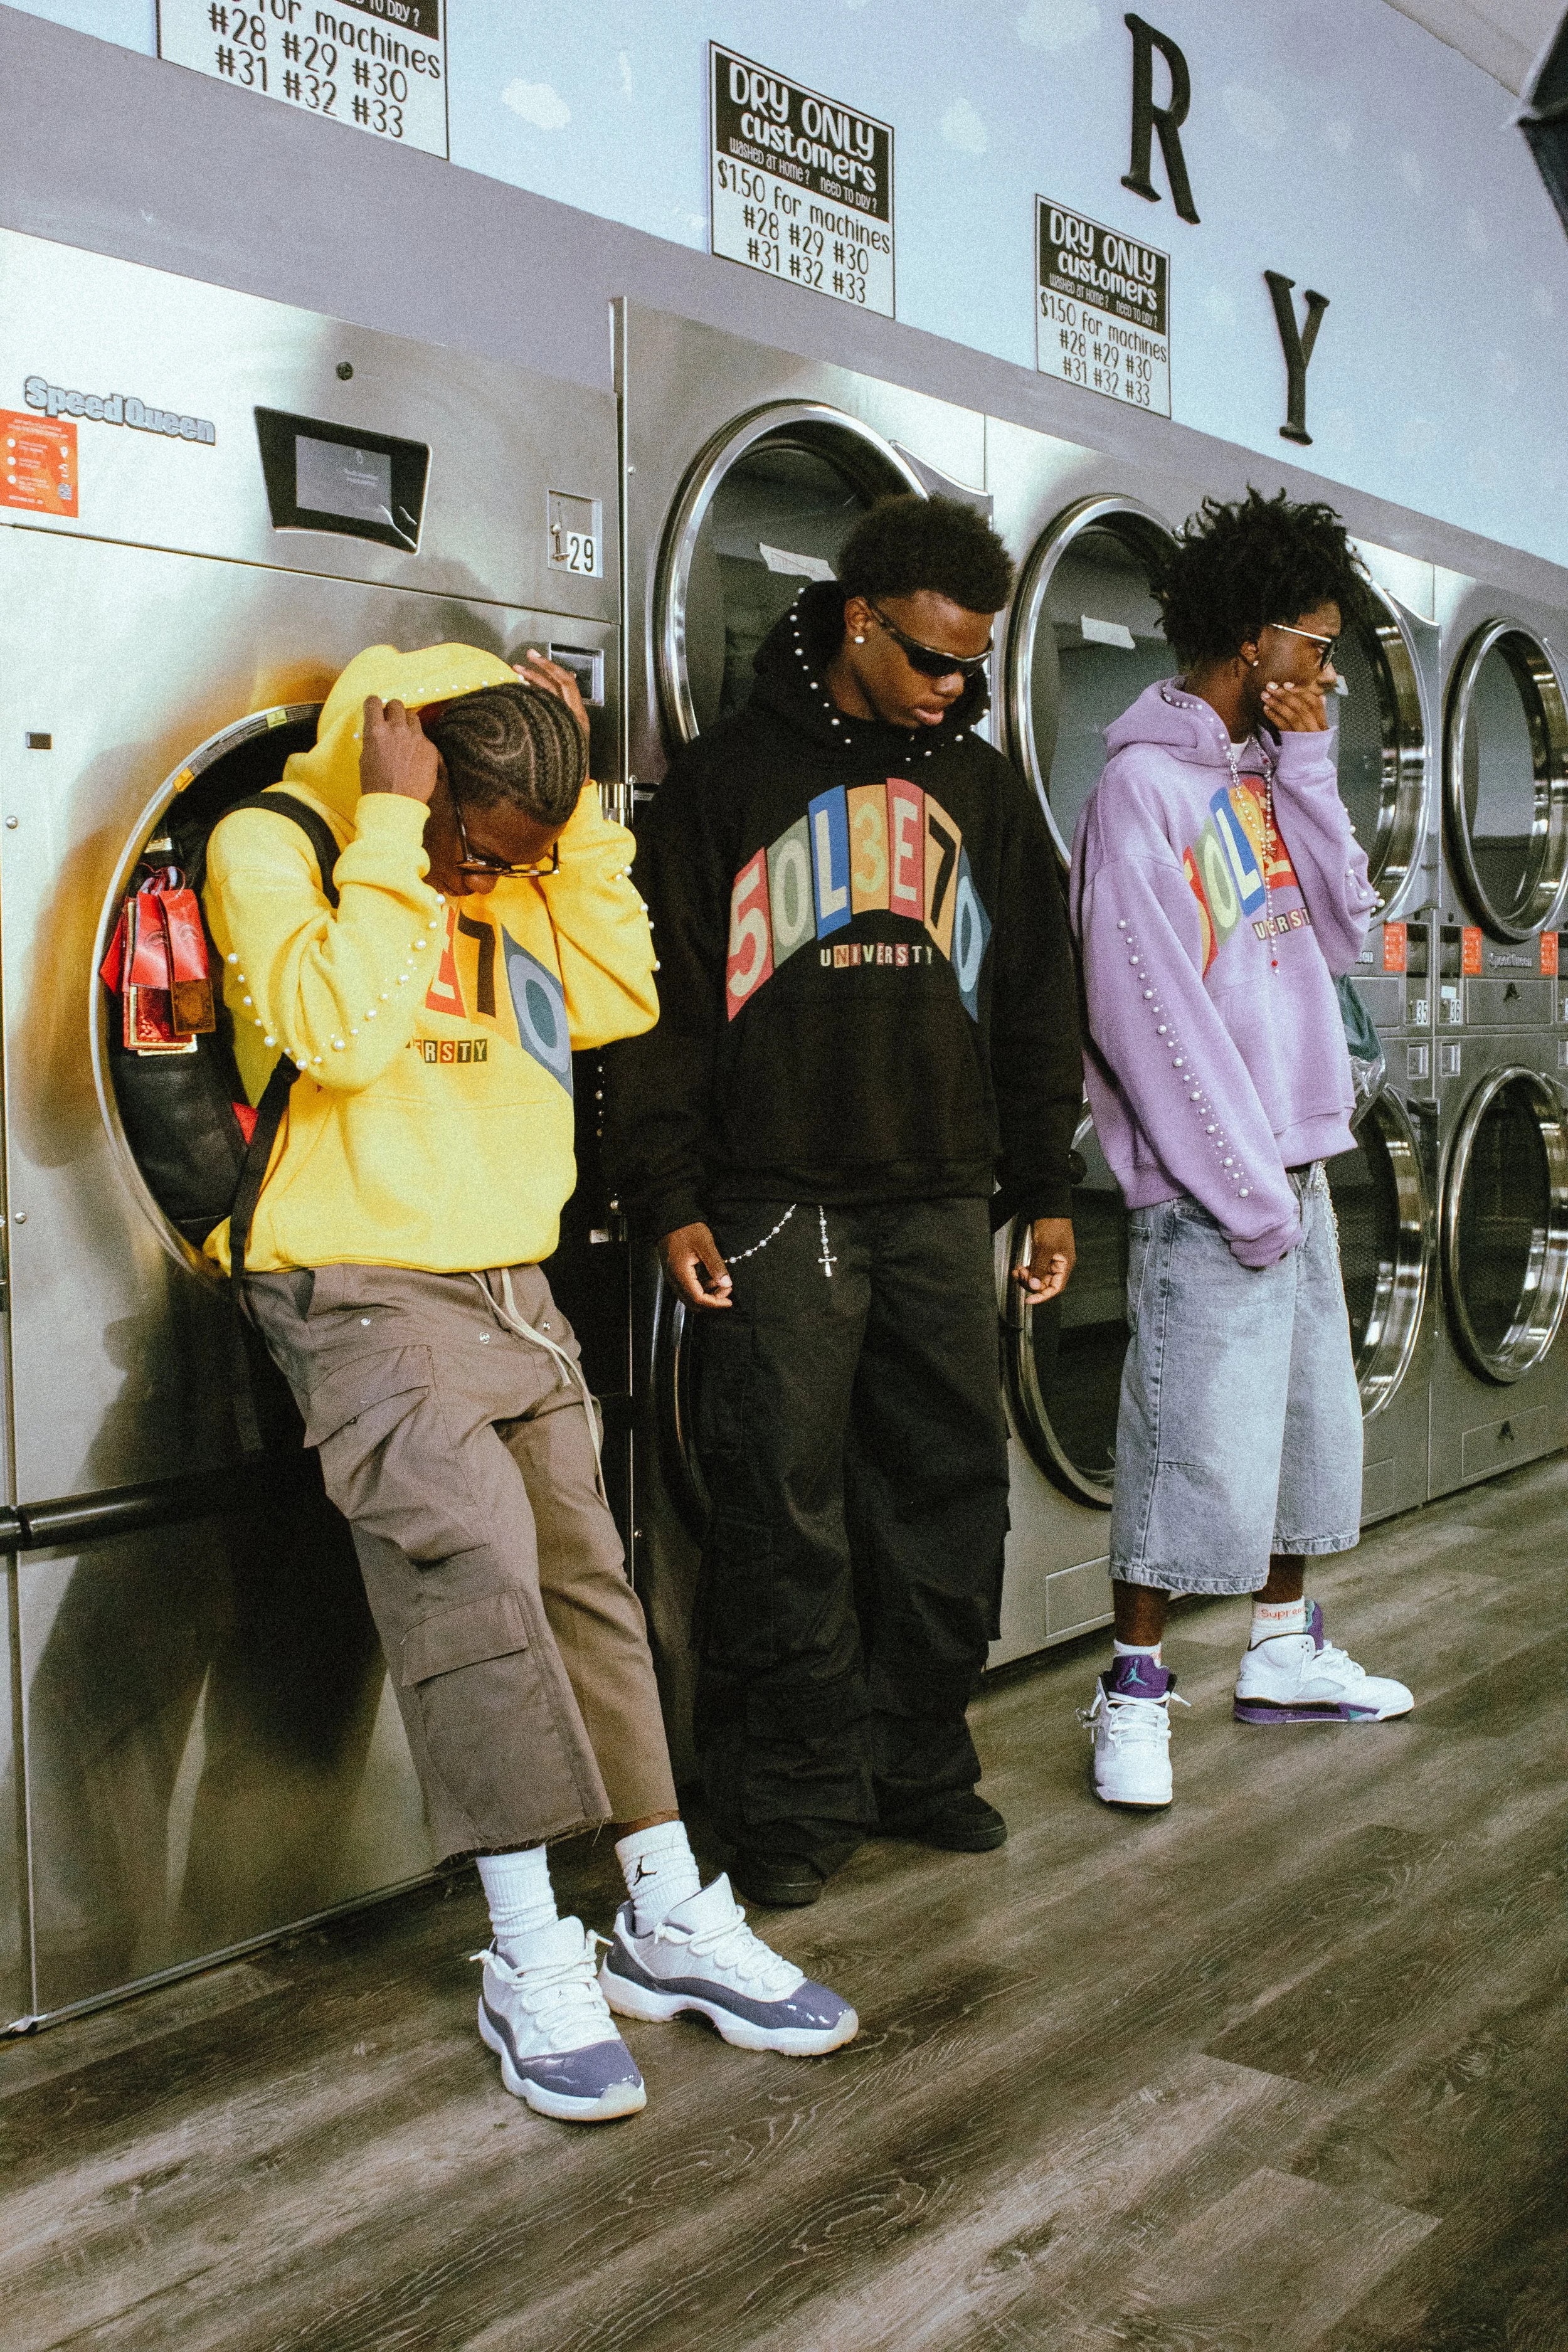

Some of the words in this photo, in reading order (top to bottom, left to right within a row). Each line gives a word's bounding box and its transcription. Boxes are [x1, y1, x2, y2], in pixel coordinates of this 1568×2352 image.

[208, 3, 267, 51] #28
[281, 31, 338, 77] #29
[352, 58, 408, 103] #30
[315, 9, 440, 79] machines
[215, 45, 268, 92] #31
[283, 70, 337, 117] #32
[351, 95, 404, 138] #33
[729, 61, 789, 123] DRY
[802, 98, 874, 162] ONLY
[1121, 13, 1200, 224] R
[741, 112, 877, 192] customers
[718, 157, 765, 203] $1.50
[774, 186, 802, 217] for
[810, 204, 890, 254] machines
[743, 204, 780, 240] #28
[788, 222, 824, 257] #29
[833, 240, 869, 275] #30
[747, 237, 780, 272] #31
[789, 253, 823, 289] #32
[832, 270, 866, 304] #33
[1050, 209, 1094, 258] DRY
[1103, 235, 1156, 285] ONLY
[1057, 251, 1157, 310] customers
[1041, 290, 1076, 327] $1.50
[1083, 310, 1103, 336] for
[1109, 324, 1167, 363] machines
[1059, 329, 1086, 358] #28
[1094, 341, 1120, 369] #29
[1126, 354, 1152, 381] #30
[1263, 270, 1330, 445] Y
[24, 376, 124, 426] Speed
[124, 396, 216, 446] Queen
[1062, 356, 1087, 384] #31
[1094, 368, 1120, 396] #32
[1126, 378, 1150, 406] #33
[570, 536, 593, 572] 29
[1418, 1002, 1427, 1022] 35
[1451, 1001, 1459, 1021] 36
